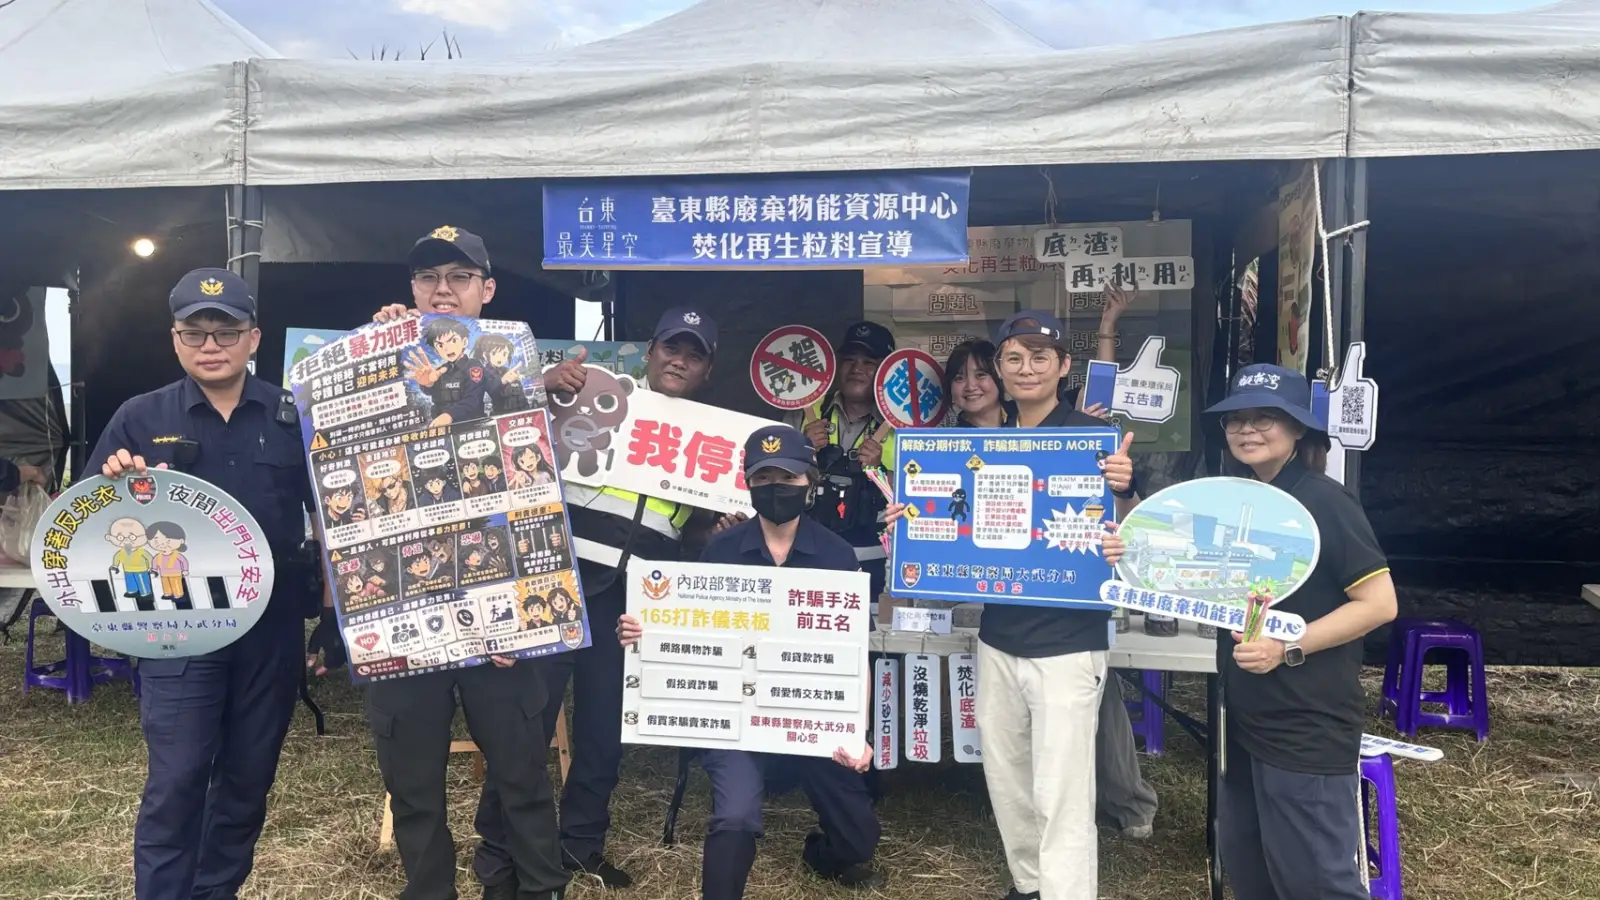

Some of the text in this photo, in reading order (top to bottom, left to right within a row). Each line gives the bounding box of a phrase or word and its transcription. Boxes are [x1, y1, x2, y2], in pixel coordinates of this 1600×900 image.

[651, 191, 958, 225] 臺東縣廢棄物能資源中心
[557, 231, 638, 259] 最美星空
[691, 230, 913, 261] 焚化再生粒料宣導
[1043, 231, 1110, 257] 底渣
[1071, 261, 1176, 288] 再利用
[929, 294, 978, 313] 問題1
[296, 318, 419, 380] 拒絕 暴力犯罪
[312, 355, 397, 390] 勇敢拒絕 不當利用
[312, 367, 399, 402] 守護自己 迎向未來
[1122, 391, 1164, 409] 五告讚
[1066, 440, 1102, 452] MORE
[41, 484, 122, 608] 外出穿著反光衣
[168, 483, 263, 602] 夜間出門才安全
[677, 574, 773, 595] 內政部警政署
[788, 588, 862, 611] 詐騙手法
[1106, 584, 1302, 635] 臺東縣廢棄物能資中心
[640, 607, 771, 632] 165打詐儀表板
[796, 611, 852, 633] 前五名
[424, 657, 440, 665] 110
[464, 647, 479, 656] 165
[659, 641, 723, 657] 網路購物詐騙
[742, 645, 835, 665] 4 假貸款詐騙
[625, 674, 719, 692] 2 假投資詐騙
[742, 681, 845, 702] 5 假愛情交友詐騙
[957, 665, 976, 729] 焚化底渣
[624, 710, 731, 731] 3 假買家騙賣家詐騙
[750, 715, 856, 734] 臺東縣警察局大武分局
[881, 671, 892, 768] 減少砂石開採
[912, 665, 929, 760] 沒燒乾淨垃圾
[787, 731, 819, 744] 關心您
